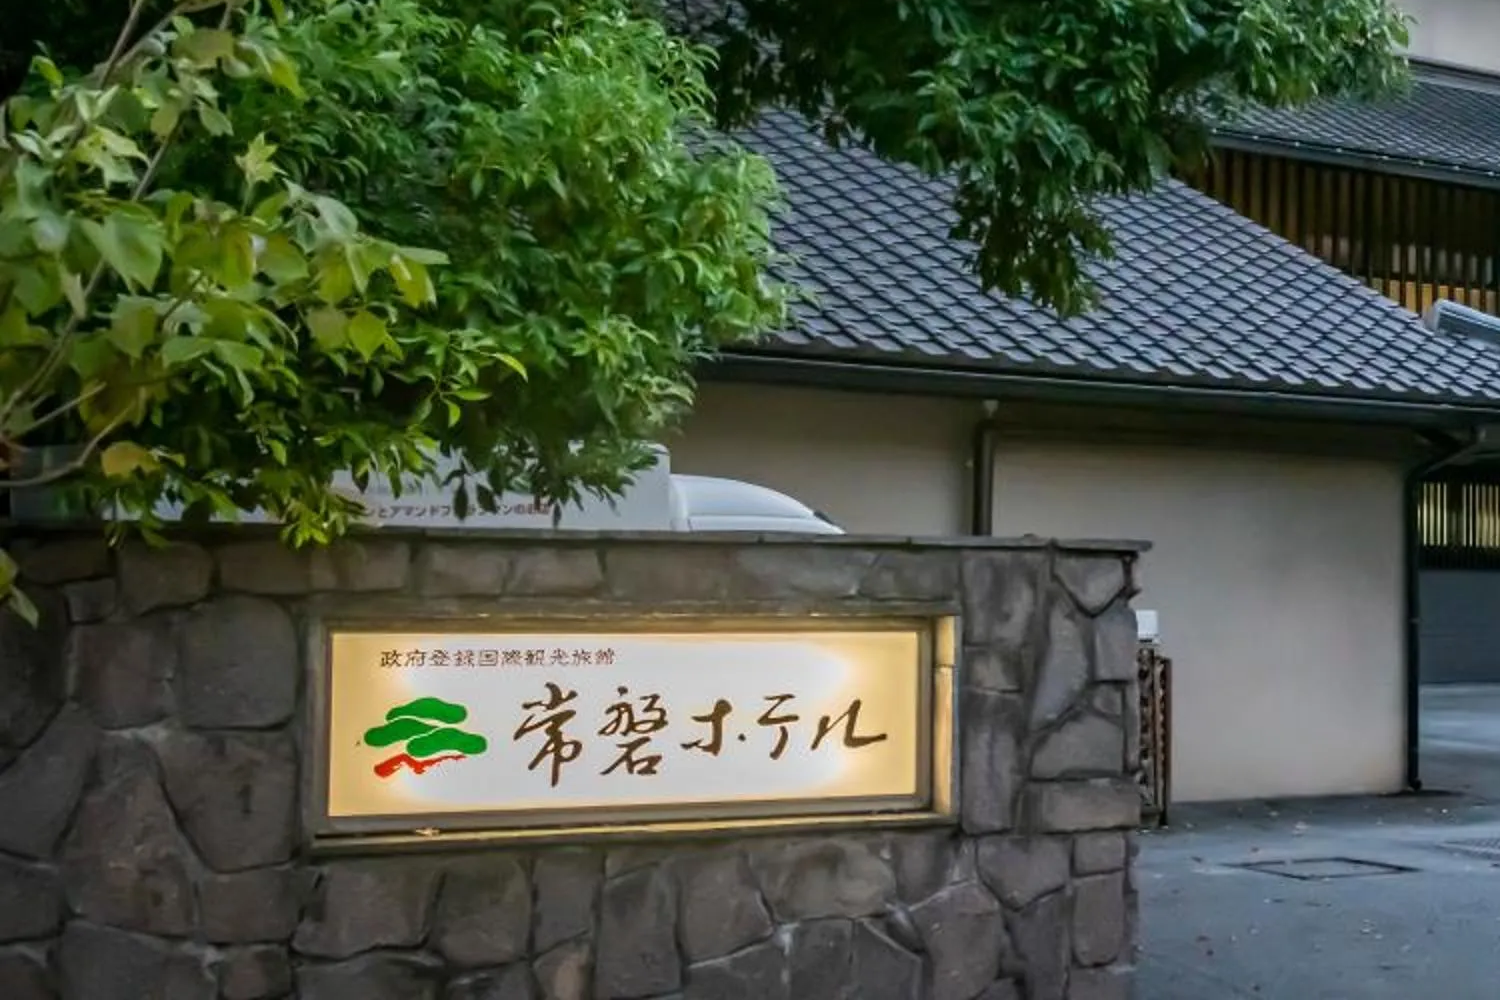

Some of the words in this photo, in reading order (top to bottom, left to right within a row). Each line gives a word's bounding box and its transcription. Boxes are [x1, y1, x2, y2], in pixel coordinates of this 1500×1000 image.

[380, 648, 615, 668] 政府登録国際観光旅館
[513, 682, 887, 788] 常磐ホテル
